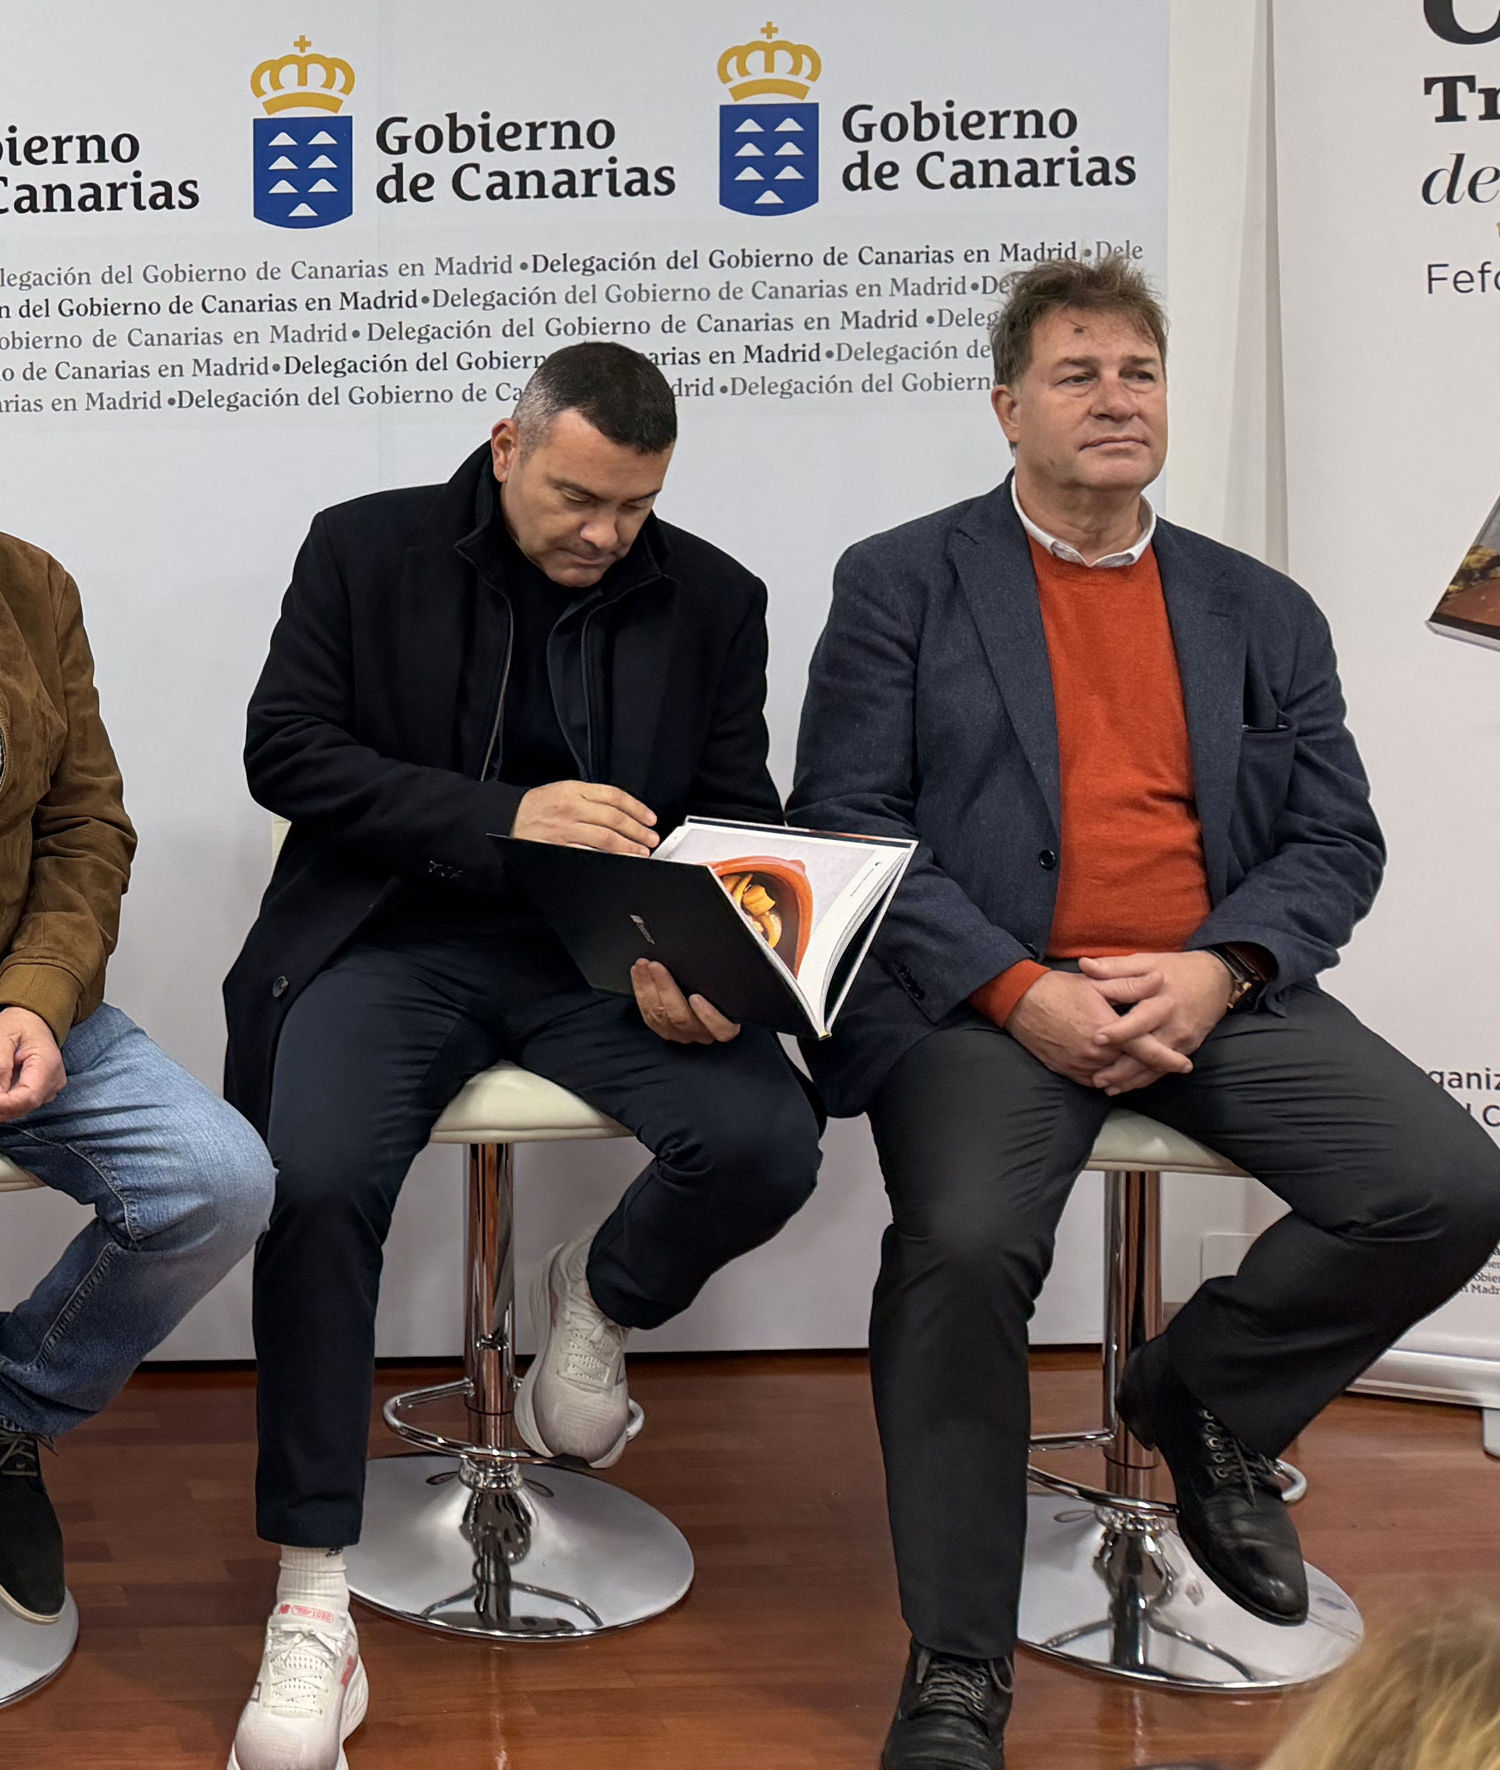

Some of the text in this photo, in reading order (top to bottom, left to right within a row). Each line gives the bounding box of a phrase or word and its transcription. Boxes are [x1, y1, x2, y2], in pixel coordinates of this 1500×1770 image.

[375, 111, 616, 156] Gobierno
[842, 99, 1078, 143] Gobierno
[376, 156, 676, 204] de Canarias
[842, 145, 1136, 192] de Canarias
[100, 264, 134, 286] del
[142, 262, 247, 285] Gobierno
[255, 260, 282, 282] de
[290, 258, 390, 281] Canarias
[397, 262, 426, 278] en
[433, 253, 514, 277] Madrid
[531, 250, 658, 278] Delegación
[665, 248, 699, 271] del
[708, 247, 814, 270] Gobierno
[822, 245, 849, 267] de
[857, 244, 955, 266] Canarias
[963, 248, 991, 264] en
[998, 240, 1078, 263] Madrid
[18, 297, 52, 319] del
[57, 296, 162, 319] Gobierno
[168, 294, 195, 316] de
[200, 292, 299, 315] Canarias
[304, 296, 333, 312] en
[338, 287, 419, 312] Madrid
[431, 285, 558, 312] Delegación
[564, 283, 598, 305] del
[604, 282, 712, 304] Gobierno
[717, 280, 744, 302] de
[750, 278, 849, 301] Canarias
[855, 282, 883, 298] en
[888, 274, 968, 298] Madrid
[91, 327, 118, 349] de
[126, 326, 224, 348] Canarias
[232, 330, 261, 345] en
[268, 321, 349, 344] Madrid
[366, 318, 493, 346] Delegación
[501, 316, 536, 339] del
[544, 315, 652, 338] Gobierno
[660, 313, 687, 335] de
[696, 311, 795, 334] Canarias
[803, 315, 832, 331] en
[839, 307, 919, 331] Madrid
[936, 306, 1001, 332] Deleg
[21, 360, 48, 382] de
[54, 359, 151, 381] Canarias
[157, 363, 186, 379] en
[190, 355, 270, 378] Madrid
[283, 352, 409, 379] Delegación
[415, 350, 449, 373] del
[455, 349, 547, 372] Gobiern
[648, 346, 702, 367] arias
[708, 350, 737, 365] en
[741, 341, 822, 365] Madrid
[835, 339, 959, 366] Delegación
[965, 338, 992, 360] de
[50, 397, 78, 413] en
[84, 389, 163, 412] Madrid
[176, 386, 300, 413] Delegación
[307, 384, 341, 407] del
[347, 383, 454, 406] Gobierno
[461, 381, 488, 403] de
[670, 376, 715, 398] drid
[729, 373, 854, 400] Delegación
[861, 372, 894, 394] del
